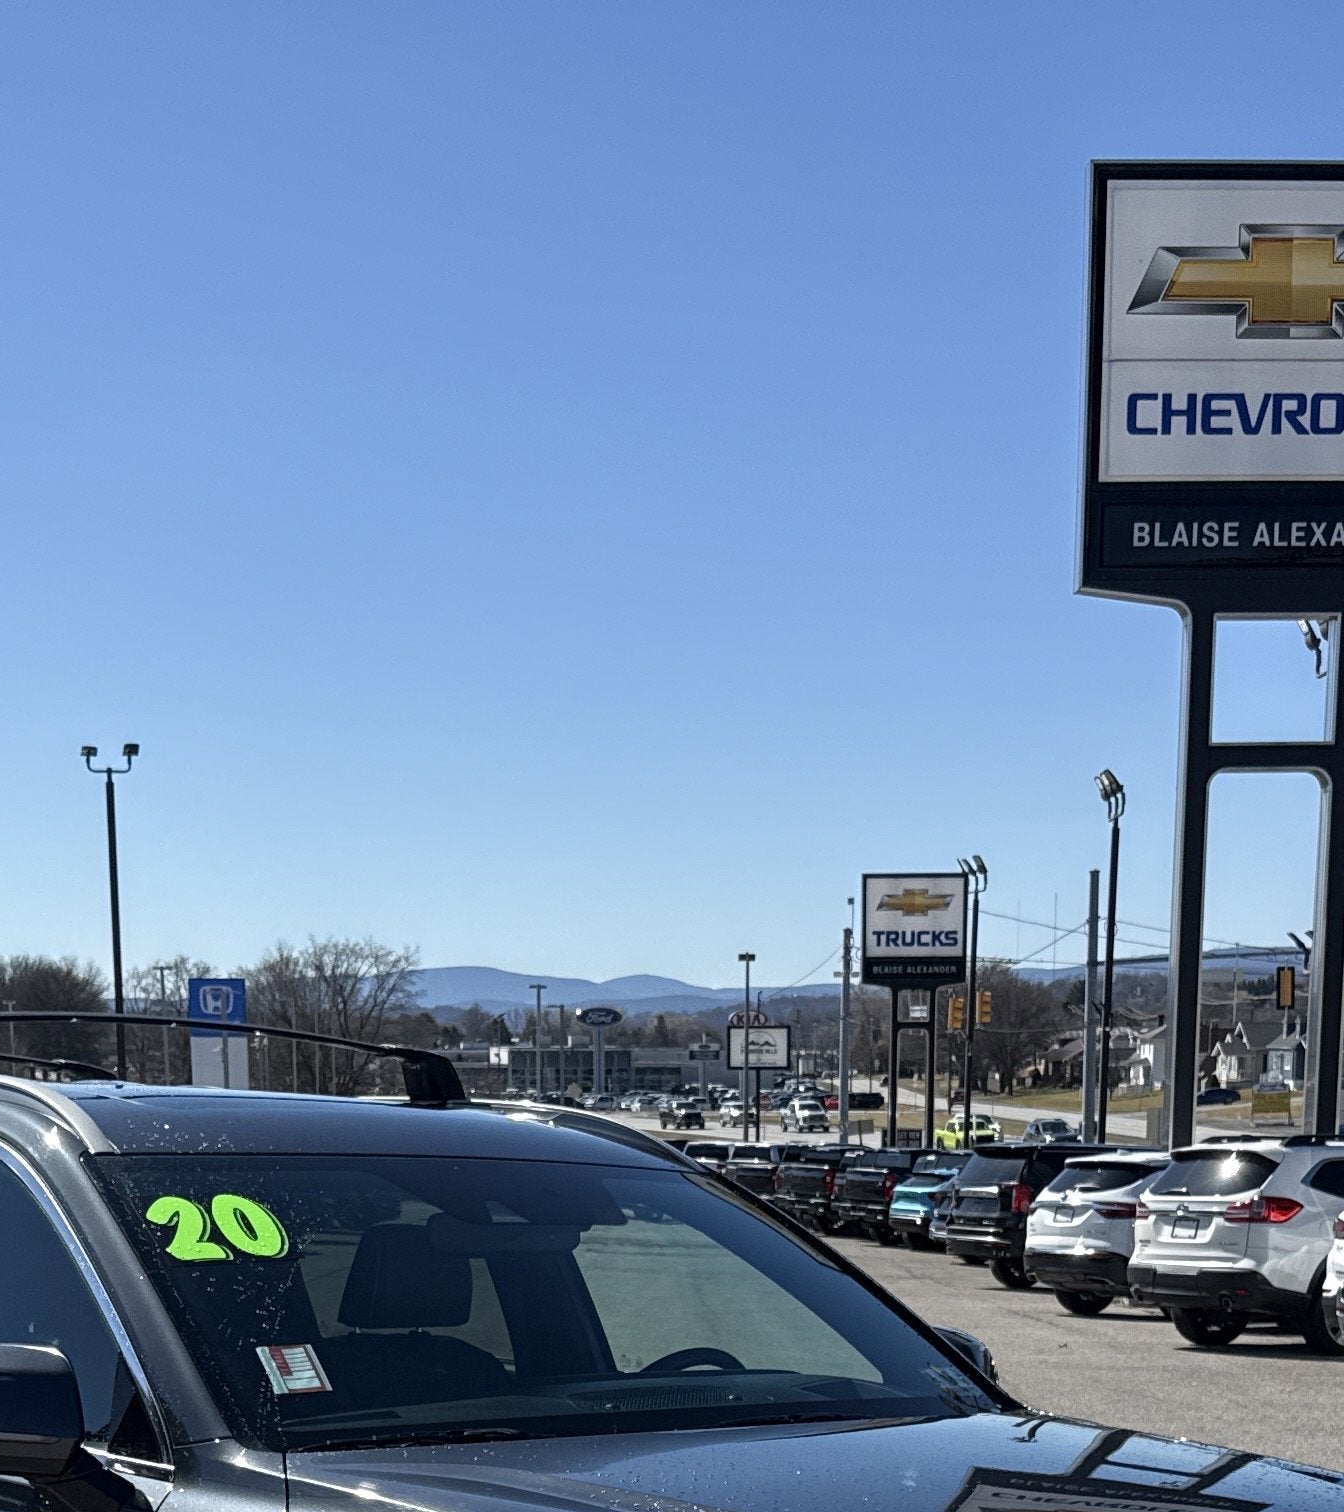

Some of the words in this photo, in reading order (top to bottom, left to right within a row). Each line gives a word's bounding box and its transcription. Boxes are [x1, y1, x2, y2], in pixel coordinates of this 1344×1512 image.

[1132, 521, 1240, 548] BLAISE
[872, 930, 959, 948] TRUCKS
[872, 966, 903, 974] BLAISE
[906, 965, 957, 974] ALEXANDER
[585, 1011, 614, 1025] Ford
[145, 1193, 290, 1262] 20
